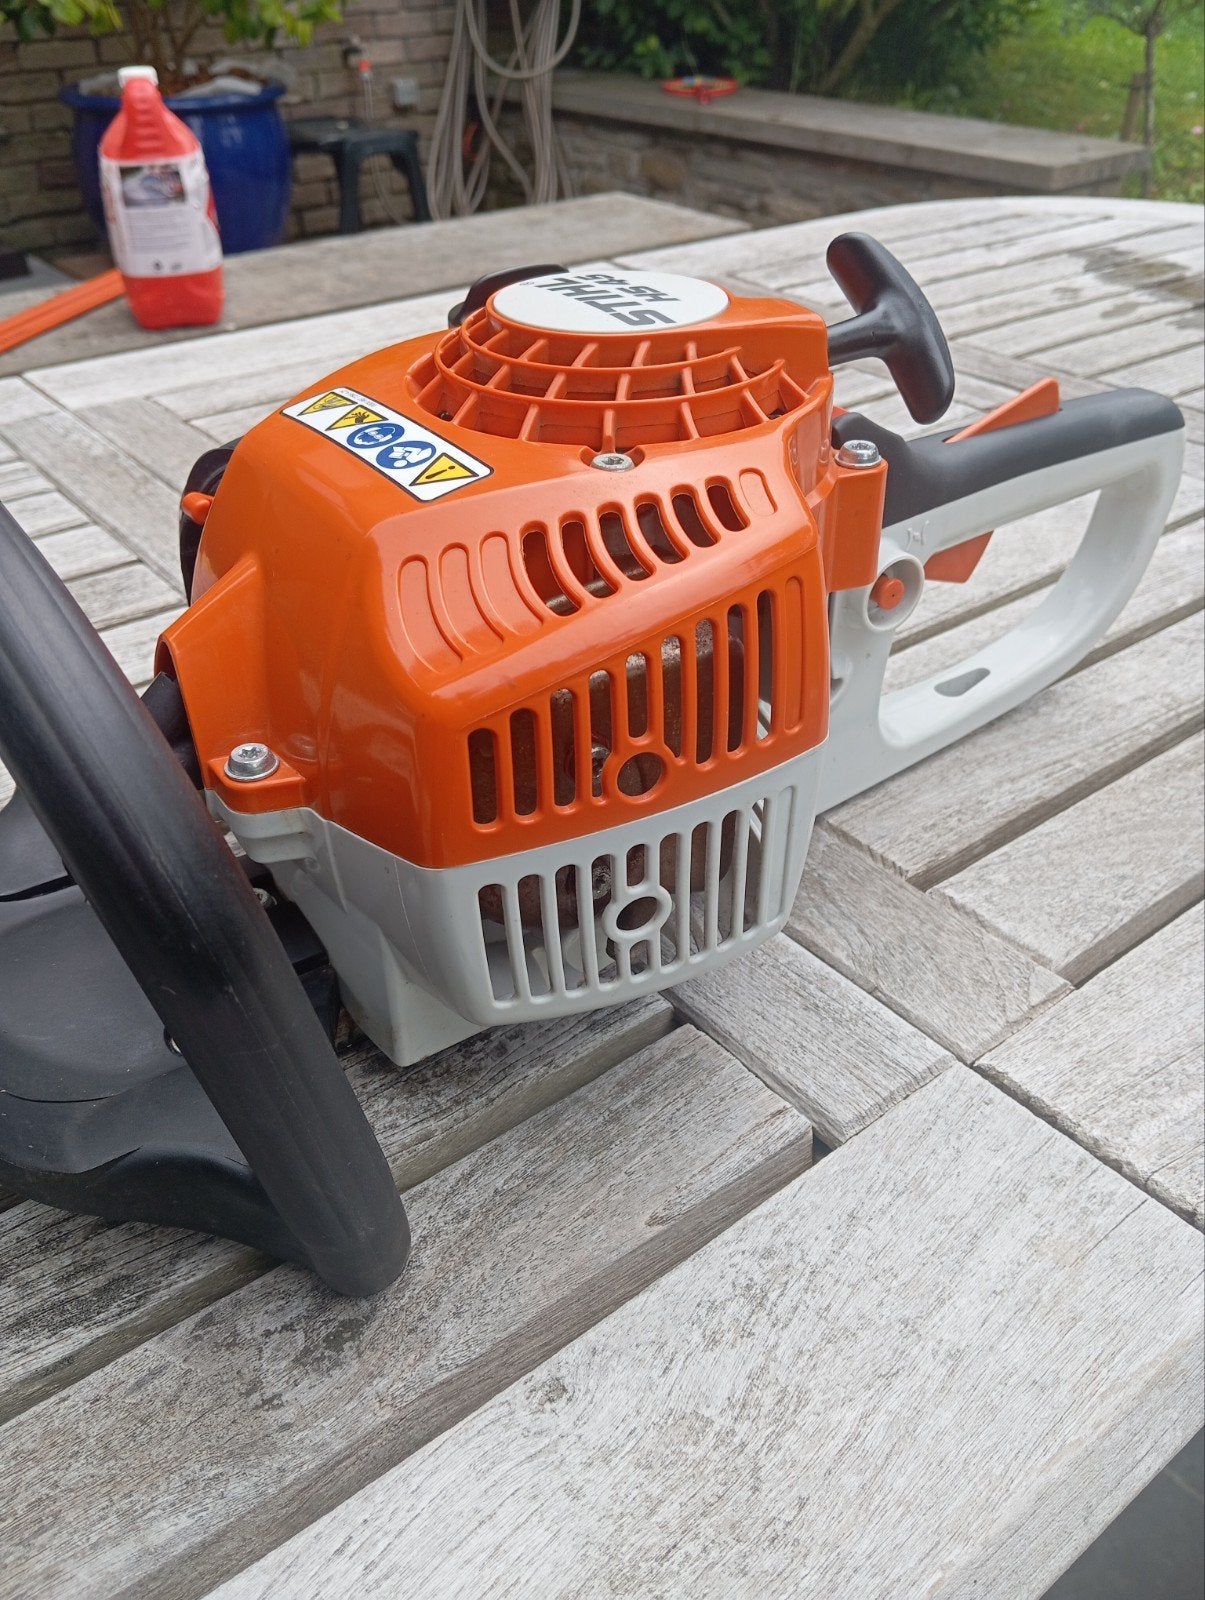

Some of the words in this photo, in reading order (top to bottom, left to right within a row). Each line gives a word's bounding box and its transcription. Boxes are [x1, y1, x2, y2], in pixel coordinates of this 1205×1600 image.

[576, 274, 630, 286] 45
[535, 277, 677, 326] STIHL
[617, 285, 682, 302] HS
